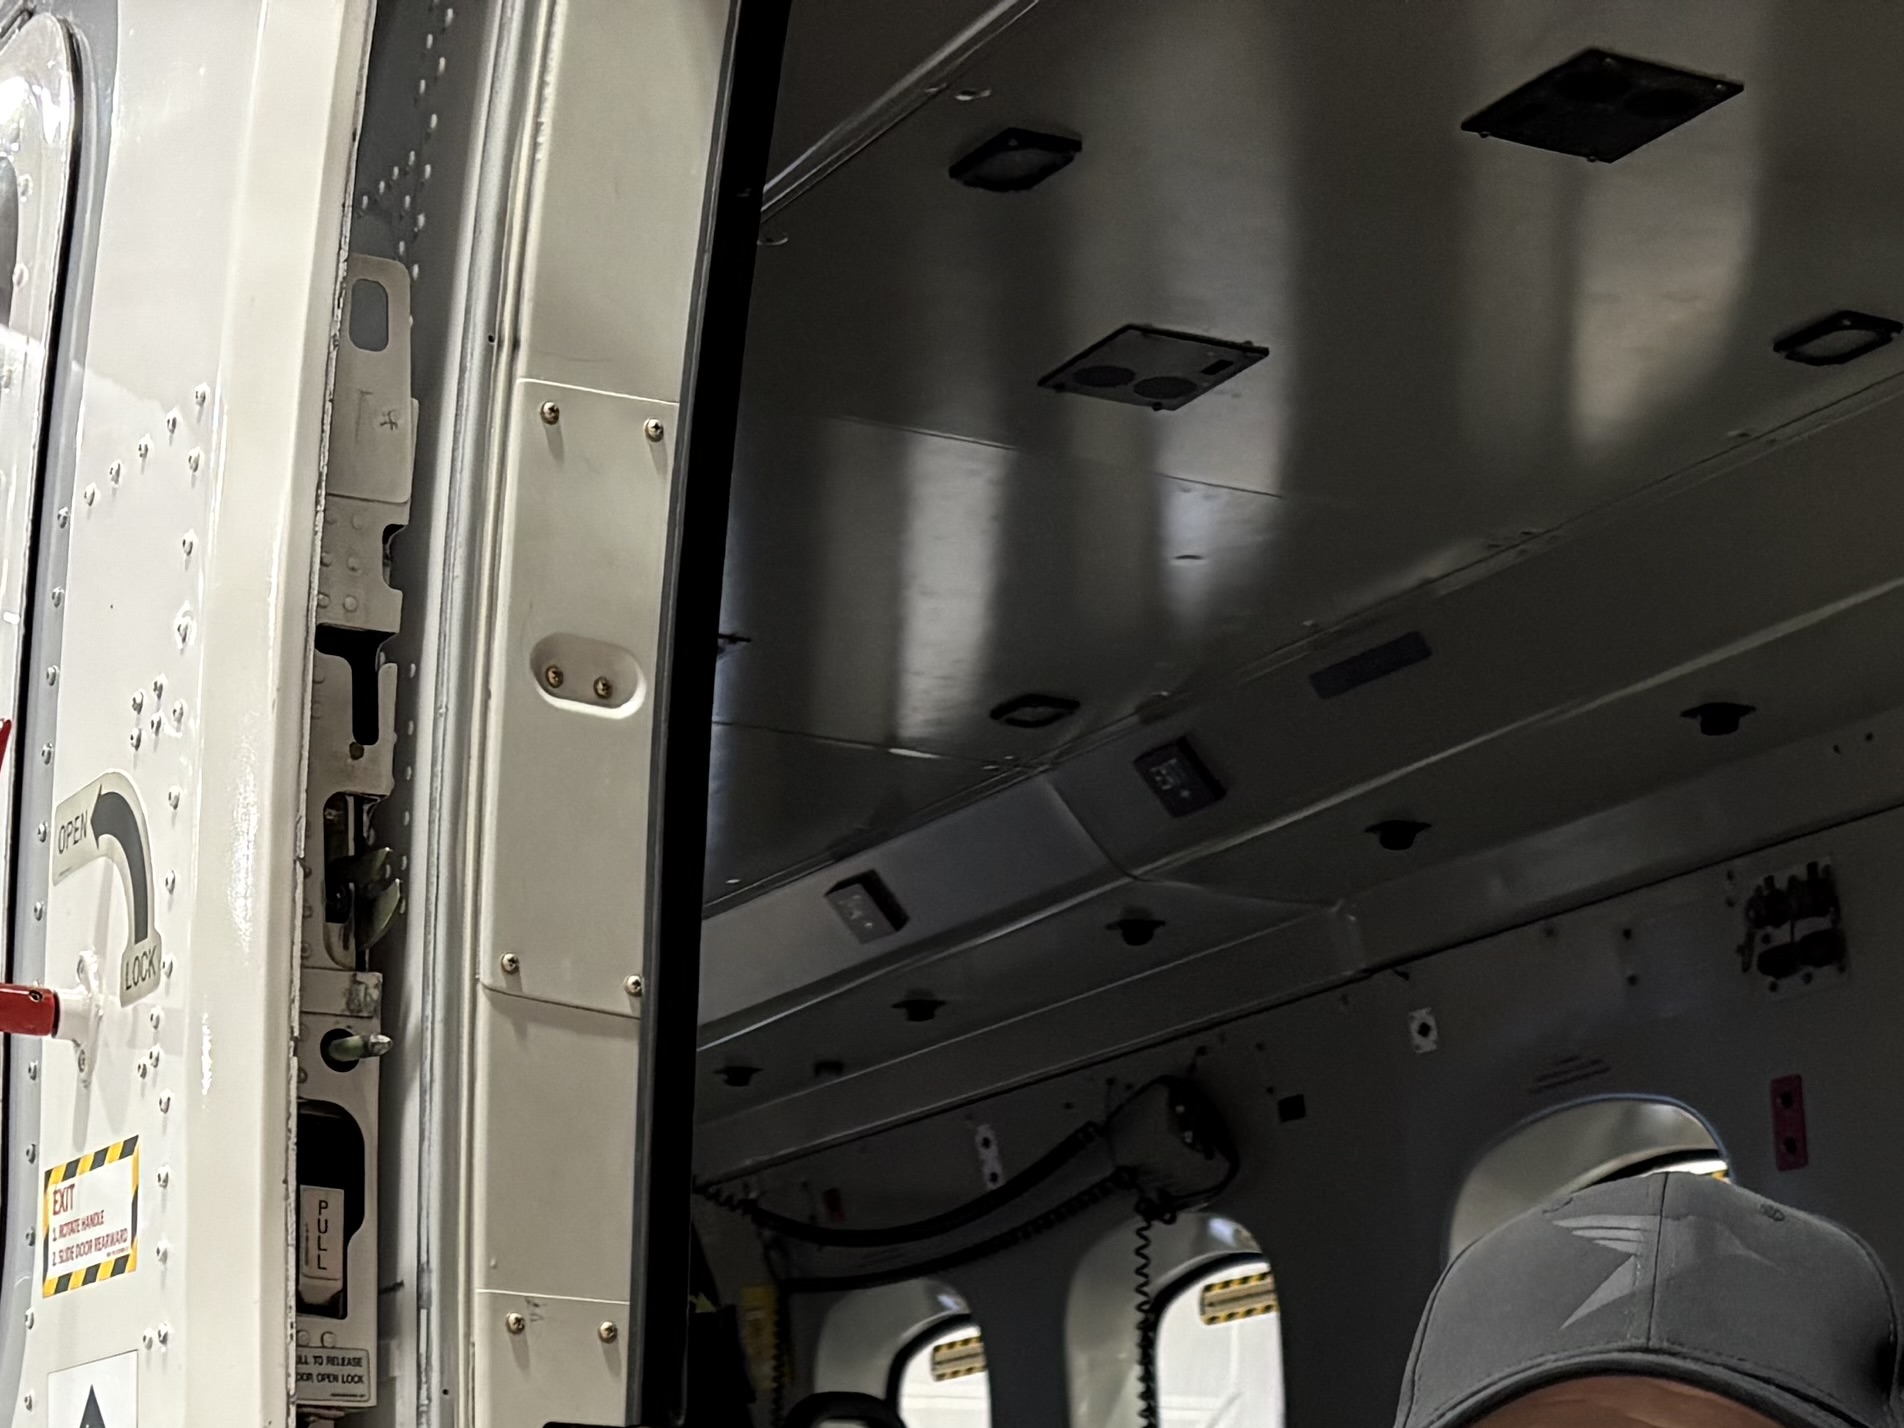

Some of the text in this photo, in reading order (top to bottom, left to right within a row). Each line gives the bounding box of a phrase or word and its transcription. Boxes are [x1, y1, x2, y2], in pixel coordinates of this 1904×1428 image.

[58, 810, 88, 854] OPEN
[125, 945, 156, 990] LOCK
[52, 1183, 75, 1216] EXIT
[58, 1217, 80, 1240] ROTATE
[81, 1209, 105, 1233] HANDLE
[317, 1200, 329, 1270] PULL
[58, 1245, 75, 1265] SLIDE
[75, 1238, 93, 1259] DOOR
[94, 1228, 129, 1253] REARWARD
[296, 1372, 365, 1384] OOR OPEN LOCK
[313, 1355, 324, 1366] TO
[326, 1356, 363, 1368] RELEASE
